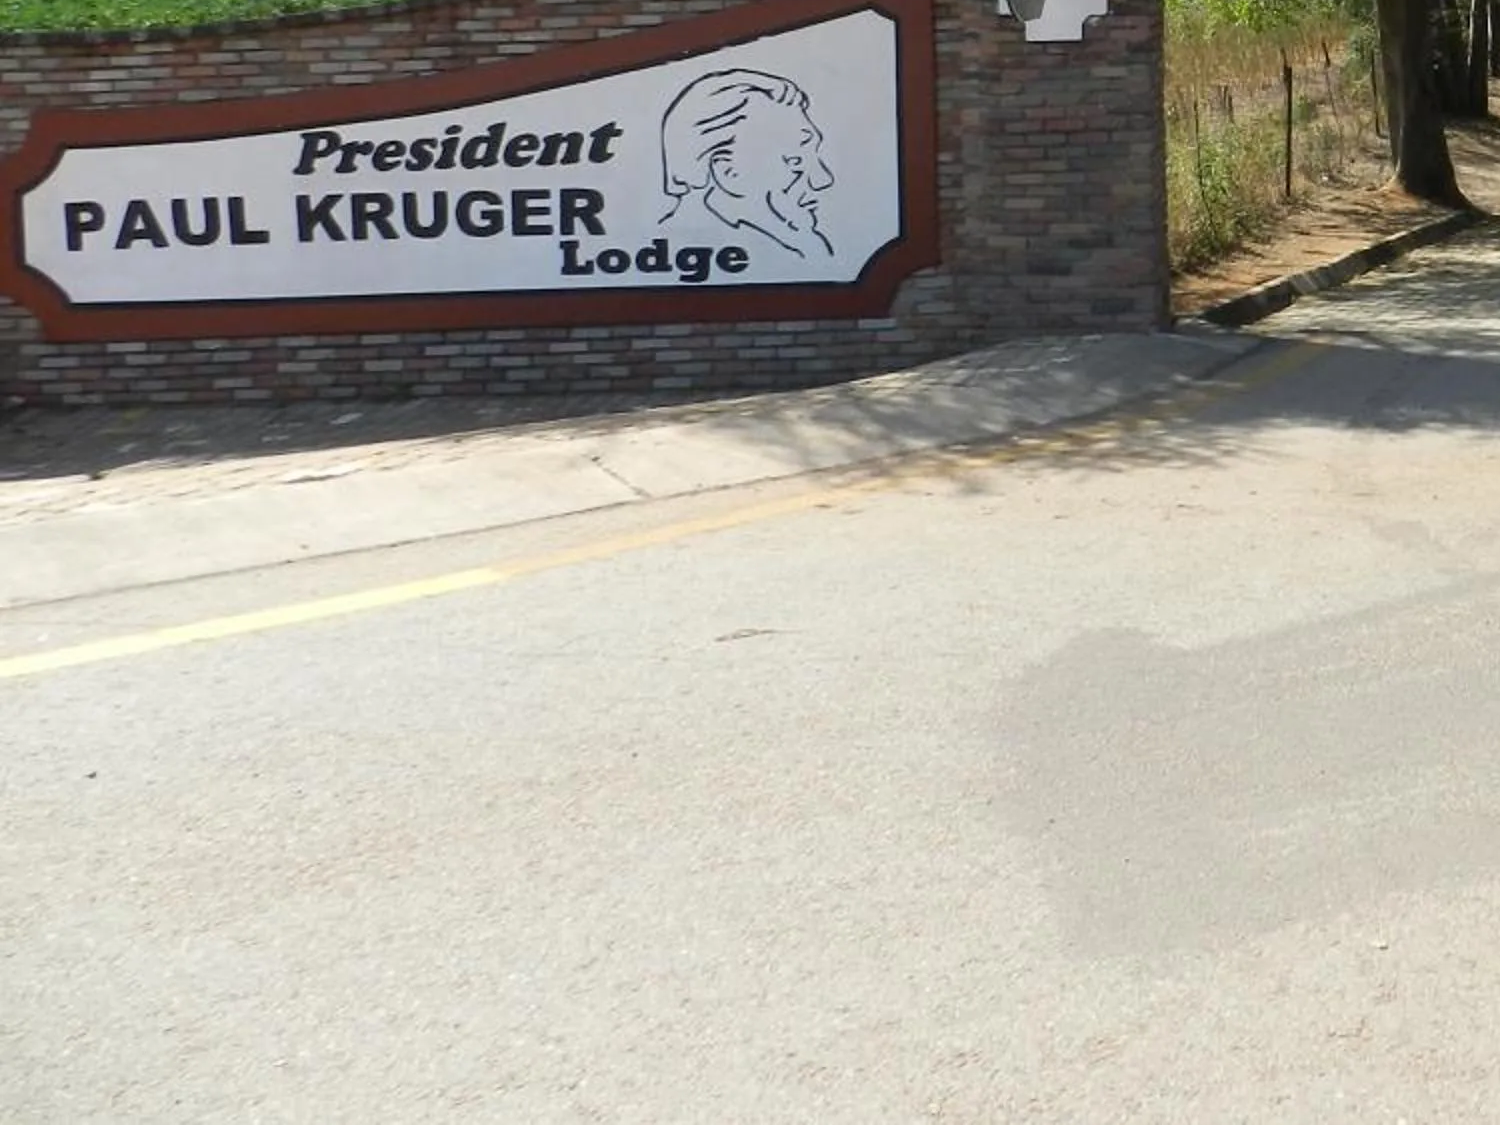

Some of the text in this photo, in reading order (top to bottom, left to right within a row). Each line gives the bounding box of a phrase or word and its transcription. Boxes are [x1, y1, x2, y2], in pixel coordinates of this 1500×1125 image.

[292, 120, 624, 176] President
[64, 187, 606, 252] PAUL KRUGER
[559, 238, 750, 284] Lodge
